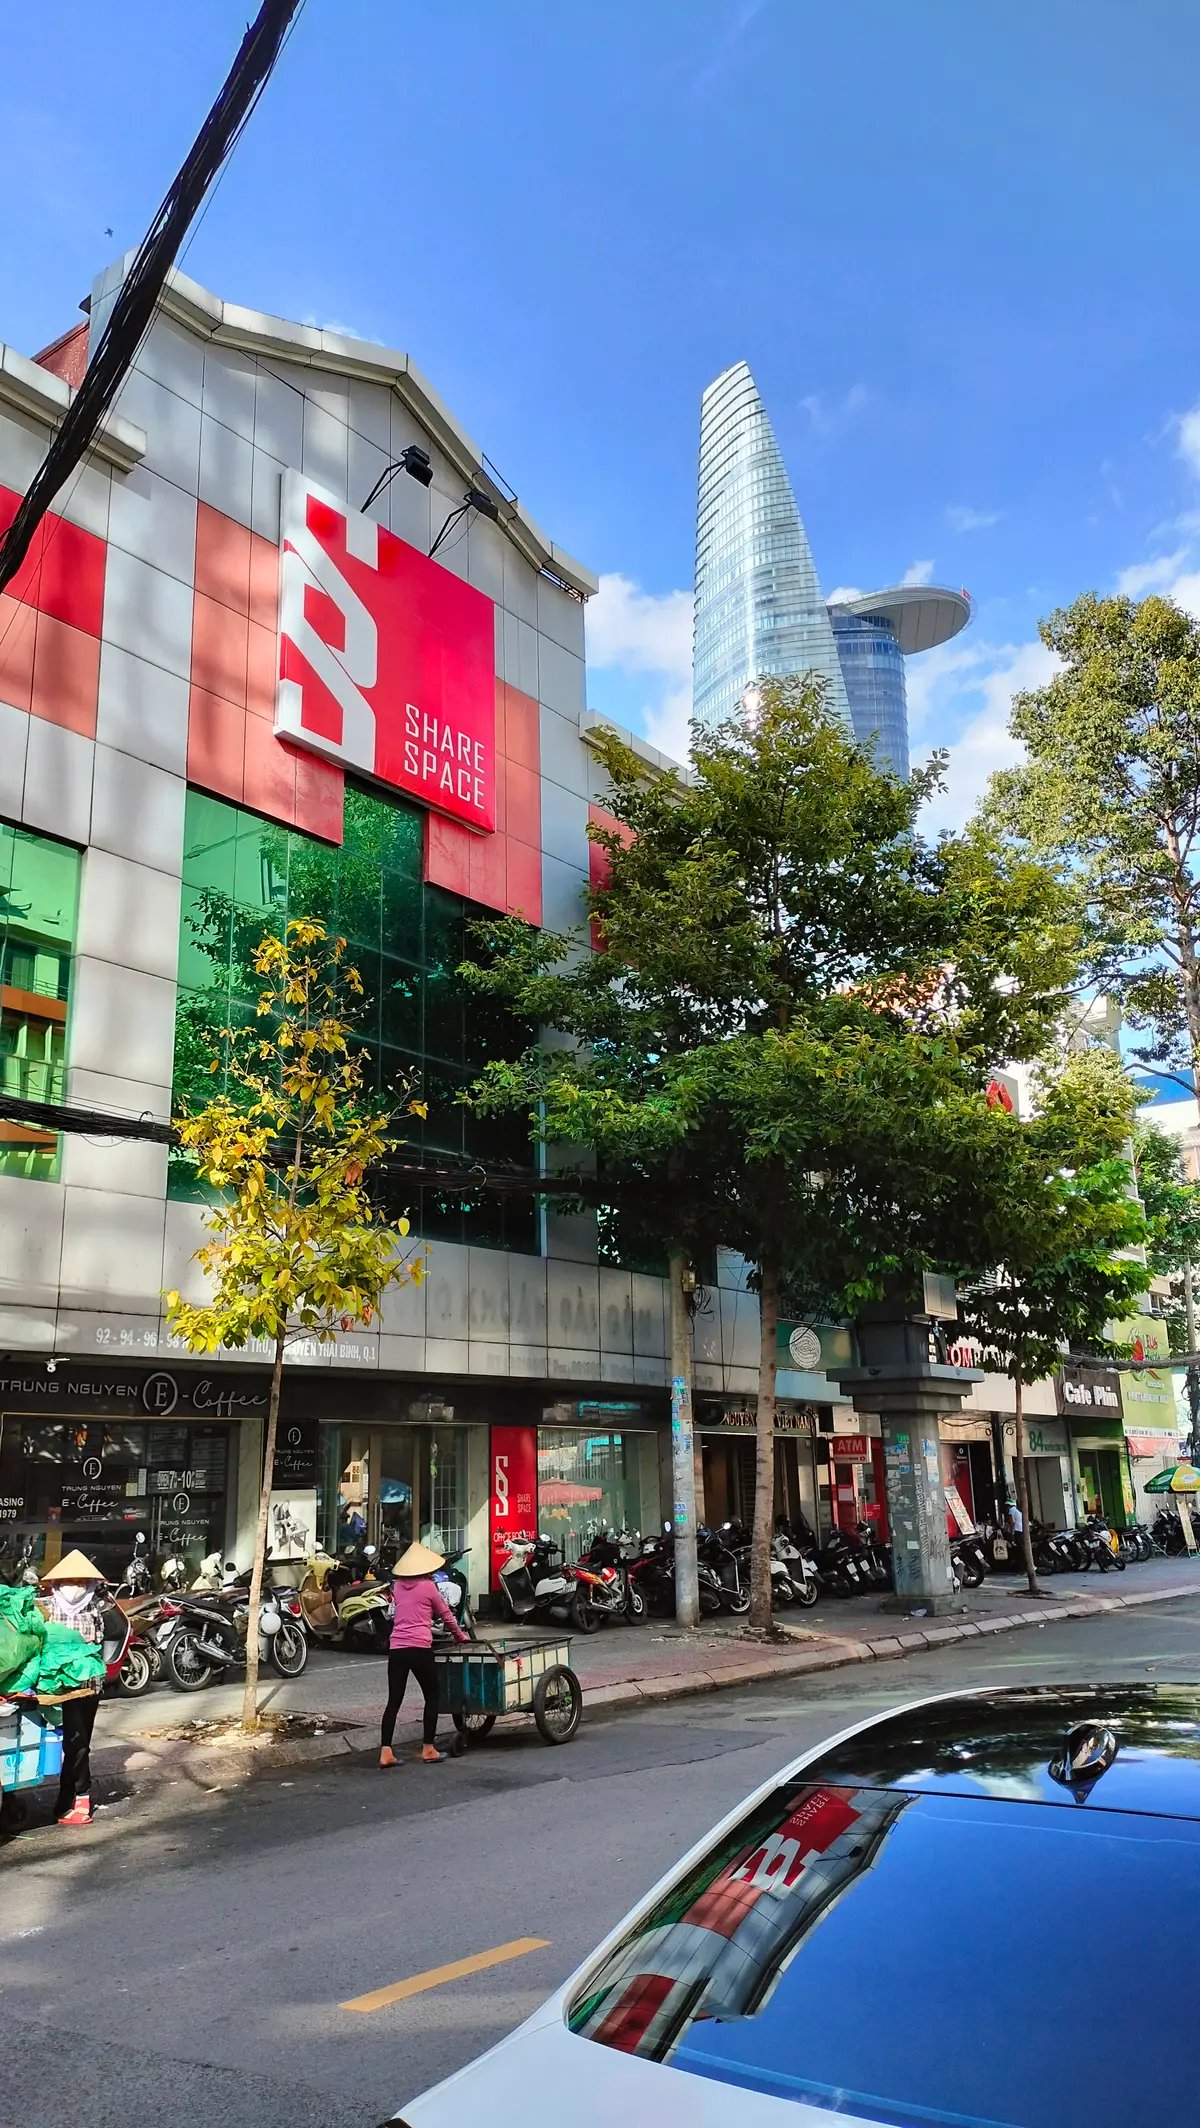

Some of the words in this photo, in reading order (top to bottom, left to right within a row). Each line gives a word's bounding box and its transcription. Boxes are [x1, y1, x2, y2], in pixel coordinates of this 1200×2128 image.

[404, 703, 485, 774] SHARE
[404, 741, 485, 810] SPACE
[96, 1328, 111, 1344] 92
[120, 1329, 133, 1345] 94
[143, 1331, 157, 1347] 96
[340, 1341, 361, 1362] BÌNH,
[363, 1346, 375, 1362] Q.1
[0, 1380, 59, 1393] TRUNG
[67, 1382, 139, 1397] NGUYEN
[193, 1380, 268, 1416] Coffee
[1063, 1381, 1092, 1406] Cafe
[1093, 1385, 1119, 1408] Phin
[837, 1439, 863, 1452] ATM
[1029, 1431, 1044, 1452] 84
[517, 1493, 532, 1503] SHARE
[517, 1503, 532, 1513] SPACE
